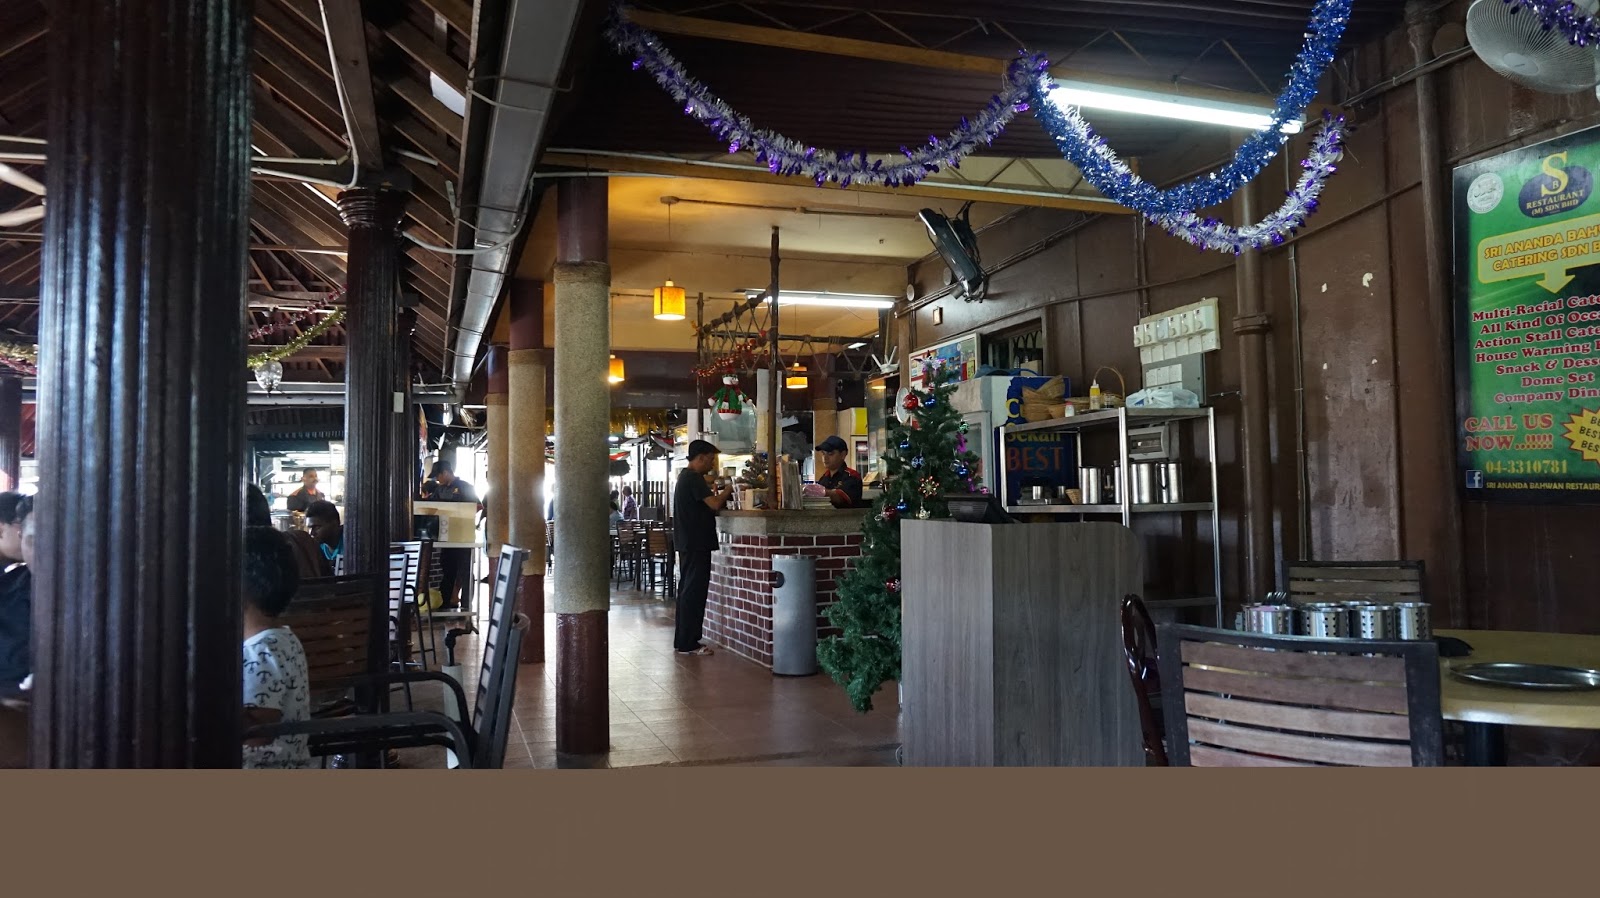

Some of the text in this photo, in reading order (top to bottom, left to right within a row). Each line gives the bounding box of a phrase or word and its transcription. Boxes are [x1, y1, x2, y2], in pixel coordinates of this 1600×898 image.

[1541, 151, 1569, 197] S
[1552, 181, 1559, 190] B
[1526, 189, 1584, 209] RESTAURANT
[1531, 198, 1579, 216] (M) SDN BHD
[1484, 224, 1600, 259] SRI ANANDA BAH
[1492, 249, 1559, 272] CATERING
[1561, 242, 1589, 259] SDN
[1472, 299, 1563, 322] Multi-Racial
[1480, 323, 1501, 335] All
[1505, 317, 1541, 331] Kind
[1545, 314, 1564, 326] Of
[1474, 335, 1521, 349] Action
[1525, 329, 1562, 343] Stall
[1475, 350, 1518, 363] House
[1522, 343, 1591, 358] Warming
[1496, 357, 1600, 375] Snack & Dess
[1521, 372, 1595, 387] Dome Set
[1494, 391, 1564, 404] Company
[1465, 414, 1553, 432] CALL US
[1006, 446, 1065, 470] BEST
[1486, 460, 1567, 474] 04-3310781
[1497, 482, 1528, 490] ANANDA
[1529, 482, 1564, 491] BAHWAN
